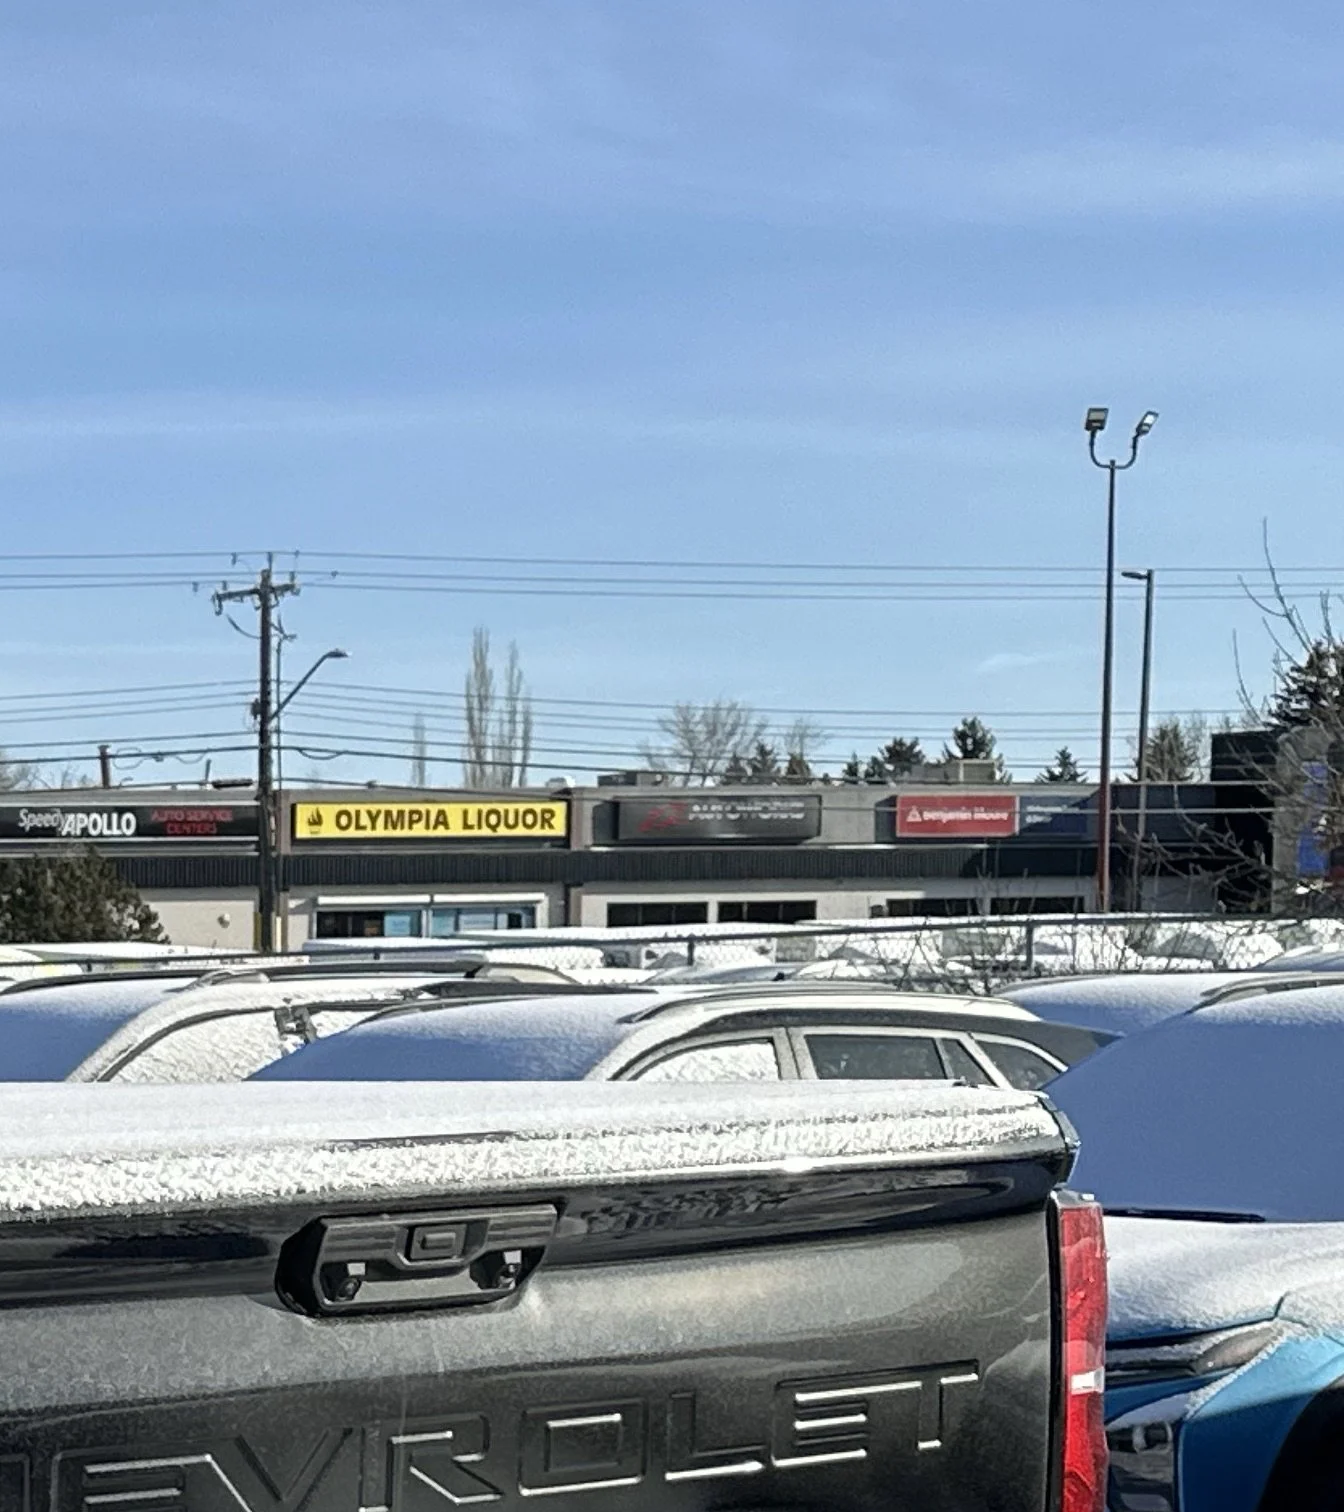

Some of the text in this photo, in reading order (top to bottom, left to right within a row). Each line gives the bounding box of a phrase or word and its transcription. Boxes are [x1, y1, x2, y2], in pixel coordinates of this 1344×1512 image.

[18, 808, 137, 837] Speedy APOLLO
[151, 809, 185, 821] AUTO
[334, 807, 557, 833] OLYMPIA LIQUOR
